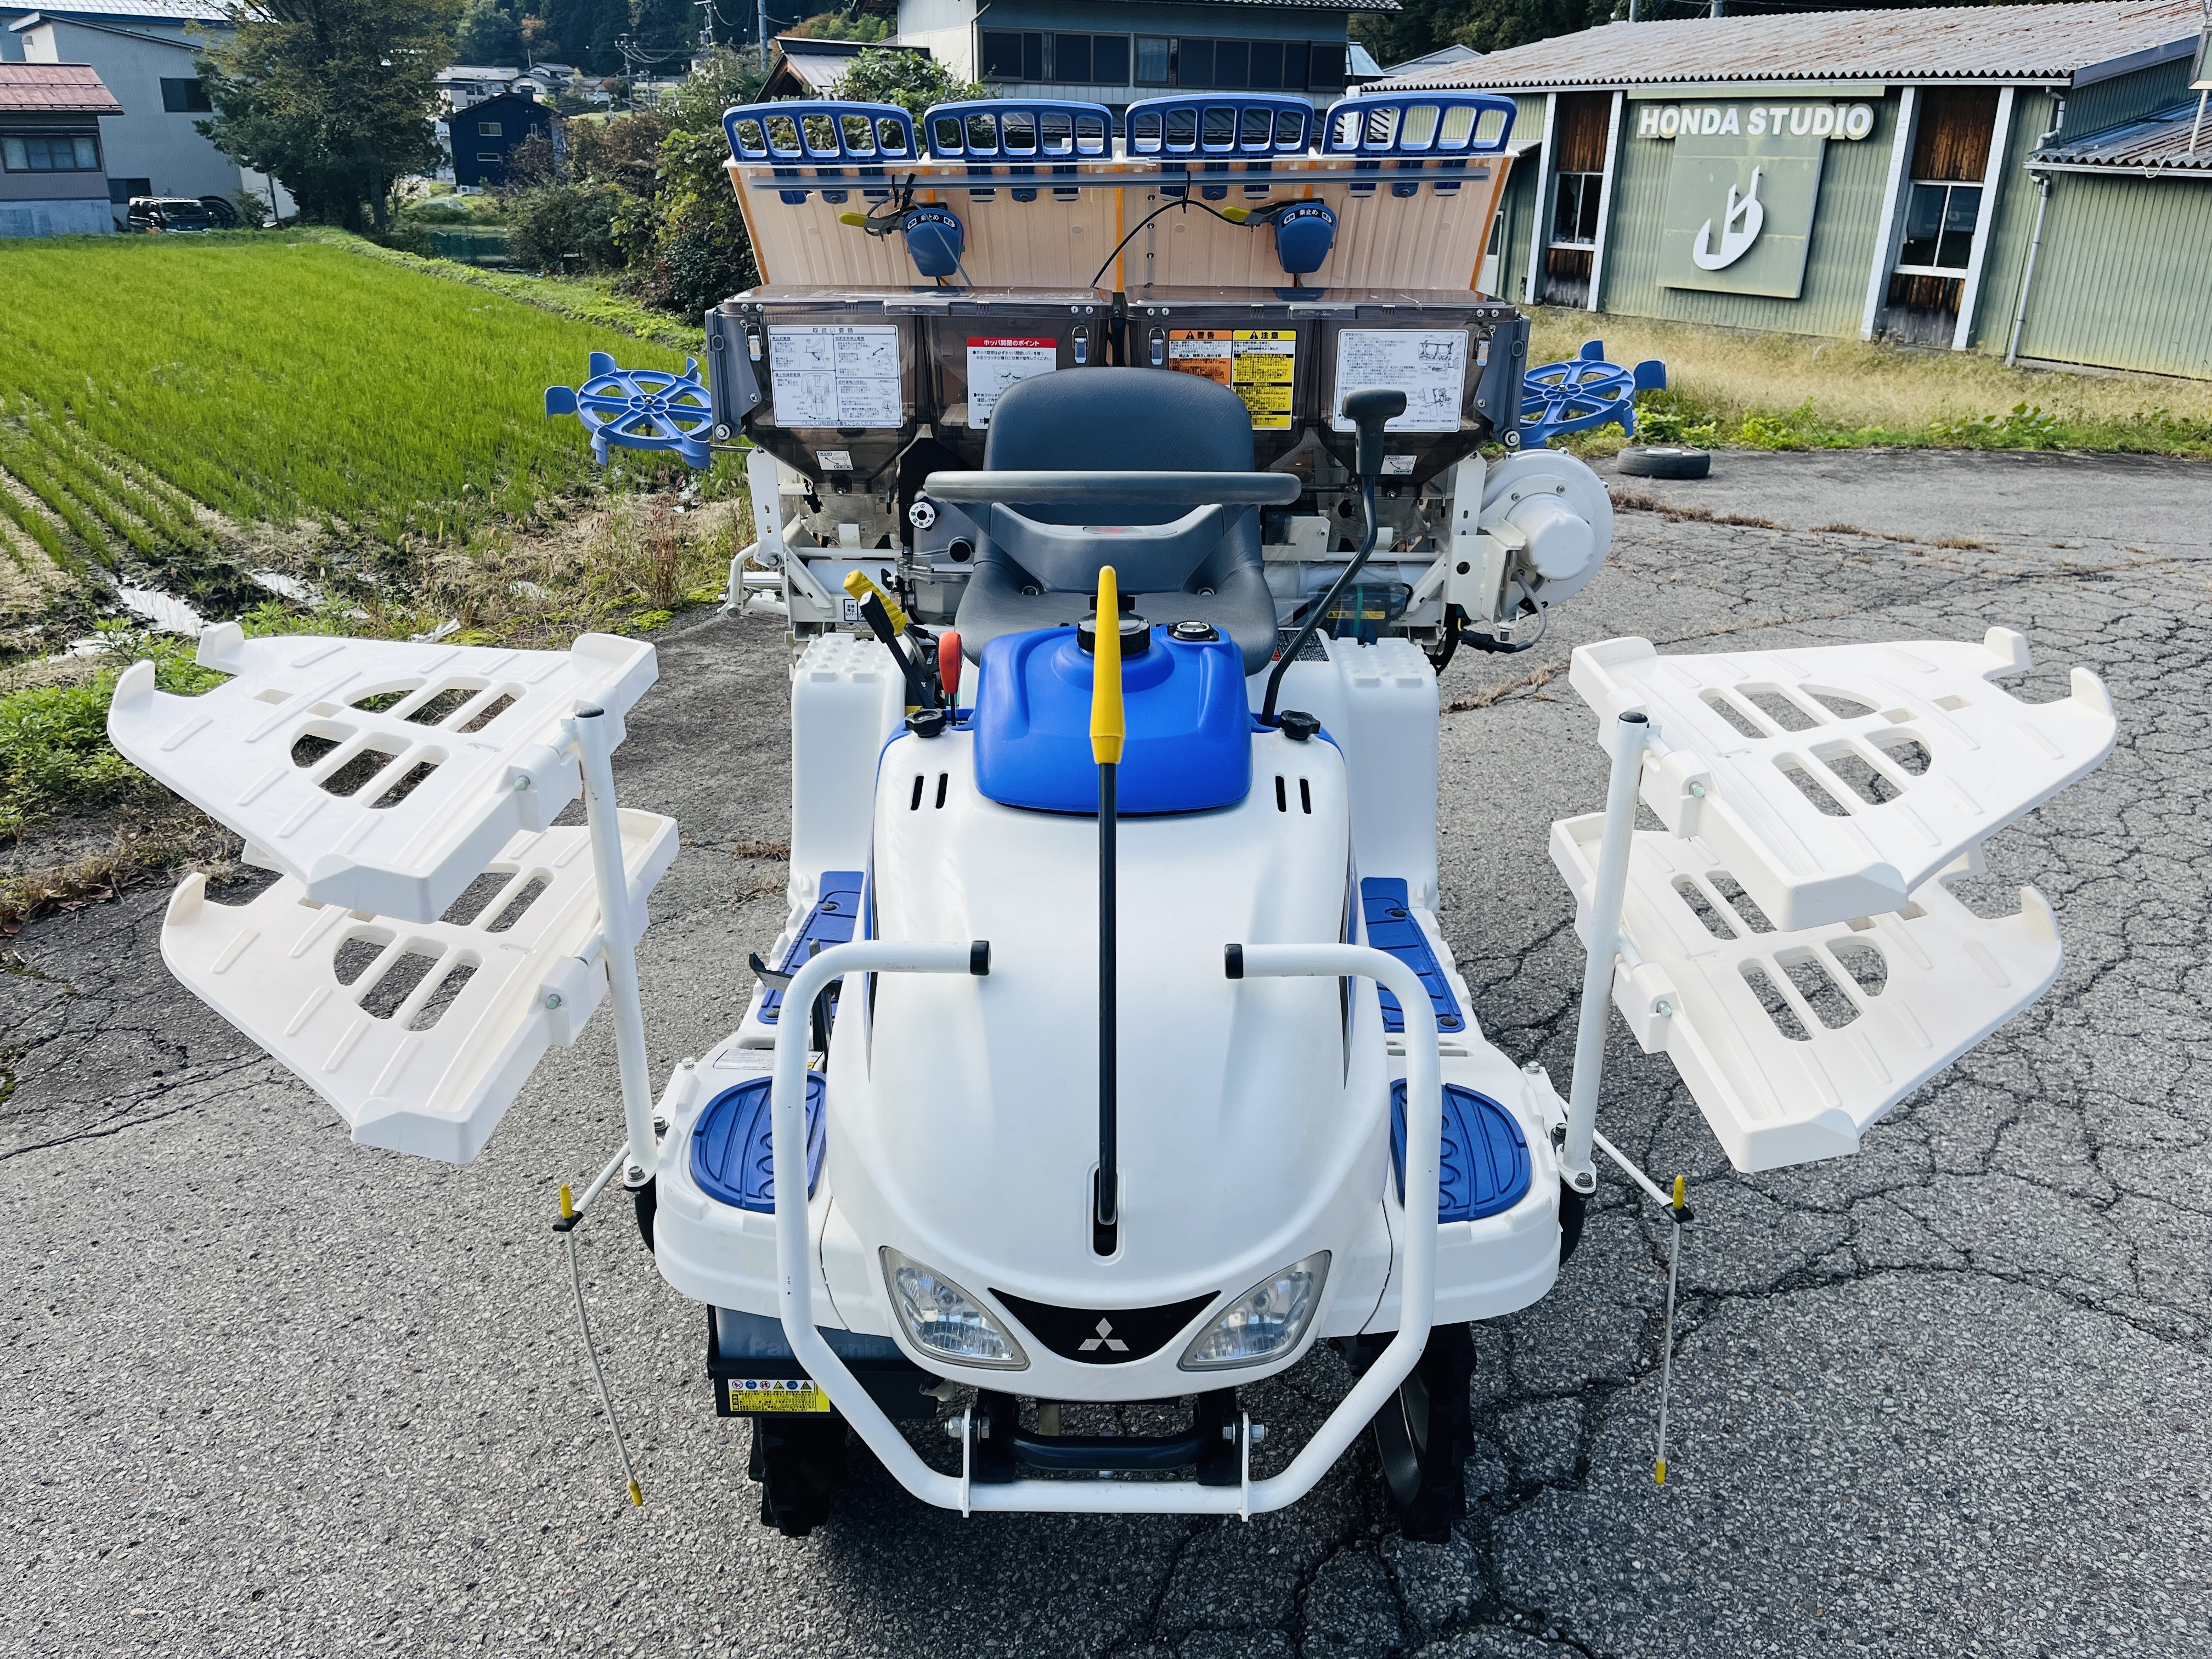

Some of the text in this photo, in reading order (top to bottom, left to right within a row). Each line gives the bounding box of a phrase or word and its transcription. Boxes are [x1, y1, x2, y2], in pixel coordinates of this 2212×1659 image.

[1639, 106, 1873, 137] HONDA STUDIO
[1197, 331, 1215, 339] 警告
